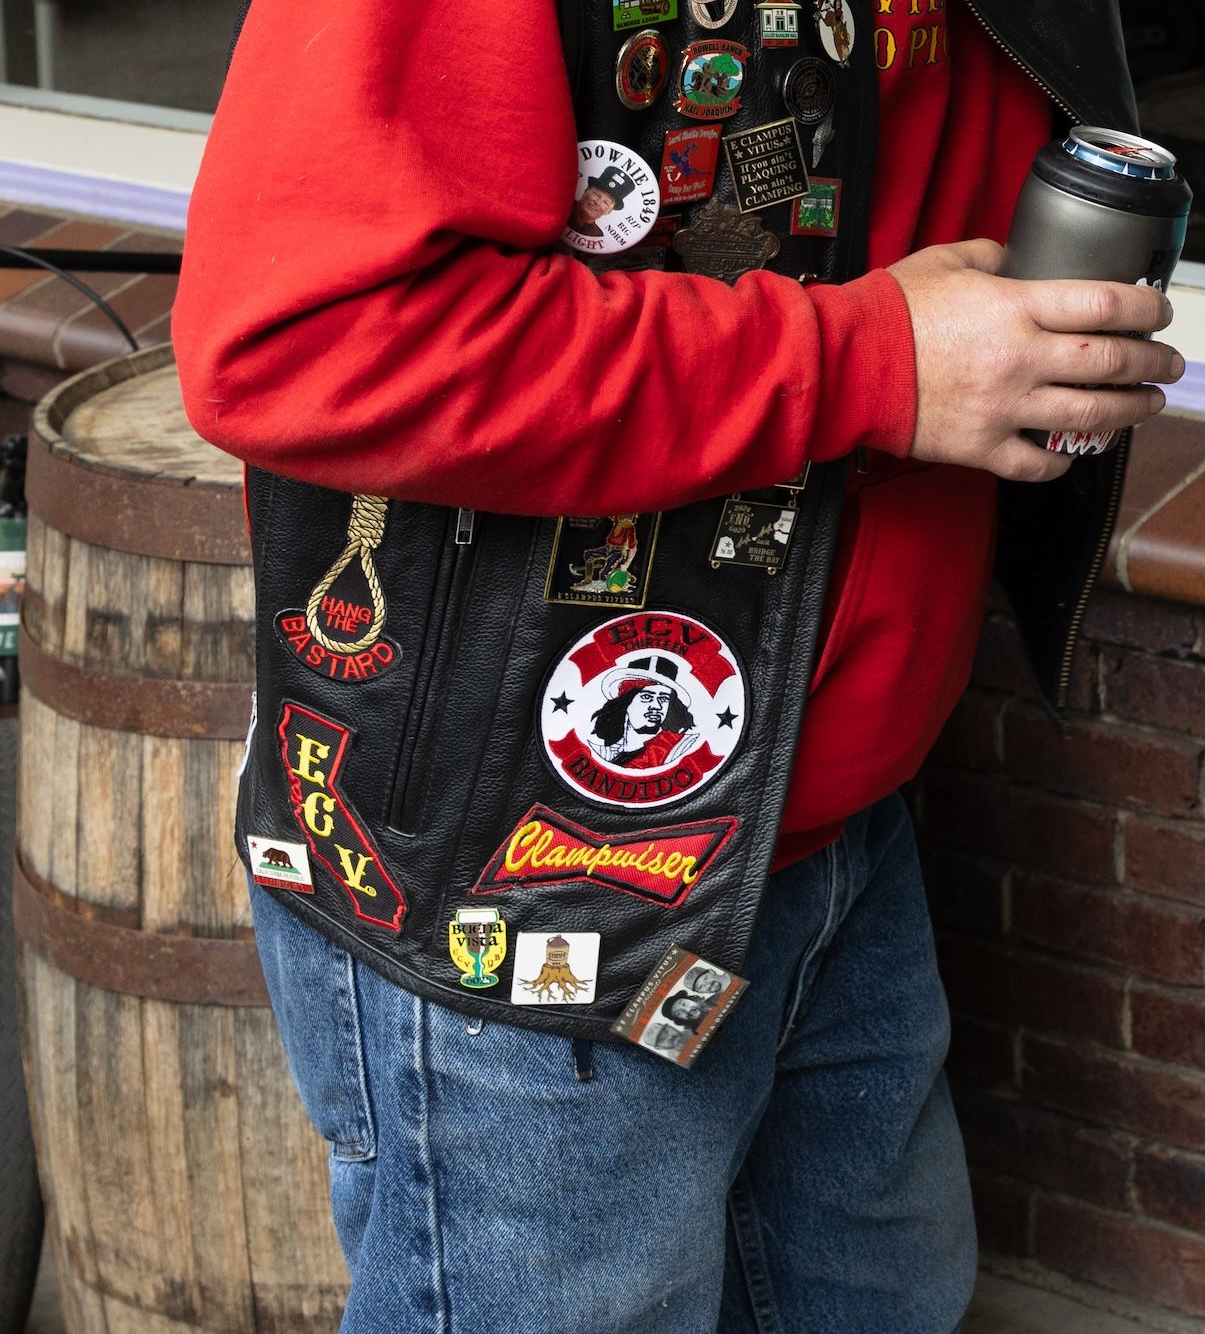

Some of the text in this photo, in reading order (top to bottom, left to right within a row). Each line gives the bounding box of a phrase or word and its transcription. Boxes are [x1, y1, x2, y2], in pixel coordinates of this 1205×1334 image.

[683, 103, 734, 117] HAIL JOAQUIN
[730, 141, 739, 151] E
[740, 124, 793, 148] CLAMPUS
[740, 151, 795, 175] If you ain't
[740, 160, 798, 185] PLAQUING
[579, 144, 649, 187] DOWNIE
[639, 188, 658, 225] 1849
[745, 182, 803, 207] CLAMPING
[750, 173, 795, 195] You ain't
[616, 222, 633, 237] BIG
[625, 215, 642, 230] RIP
[604, 224, 628, 247] NORM
[747, 546, 777, 556] BRIDGE
[321, 594, 373, 624] HANG
[325, 610, 360, 635] THE
[607, 616, 709, 645] ECV
[281, 616, 395, 680] BASTARD
[621, 636, 689, 657] THIRTEEN
[568, 754, 694, 799] BANDIDO
[504, 820, 699, 885] Clampwiser
[626, 955, 674, 1018] CLAMPUS VITUS
